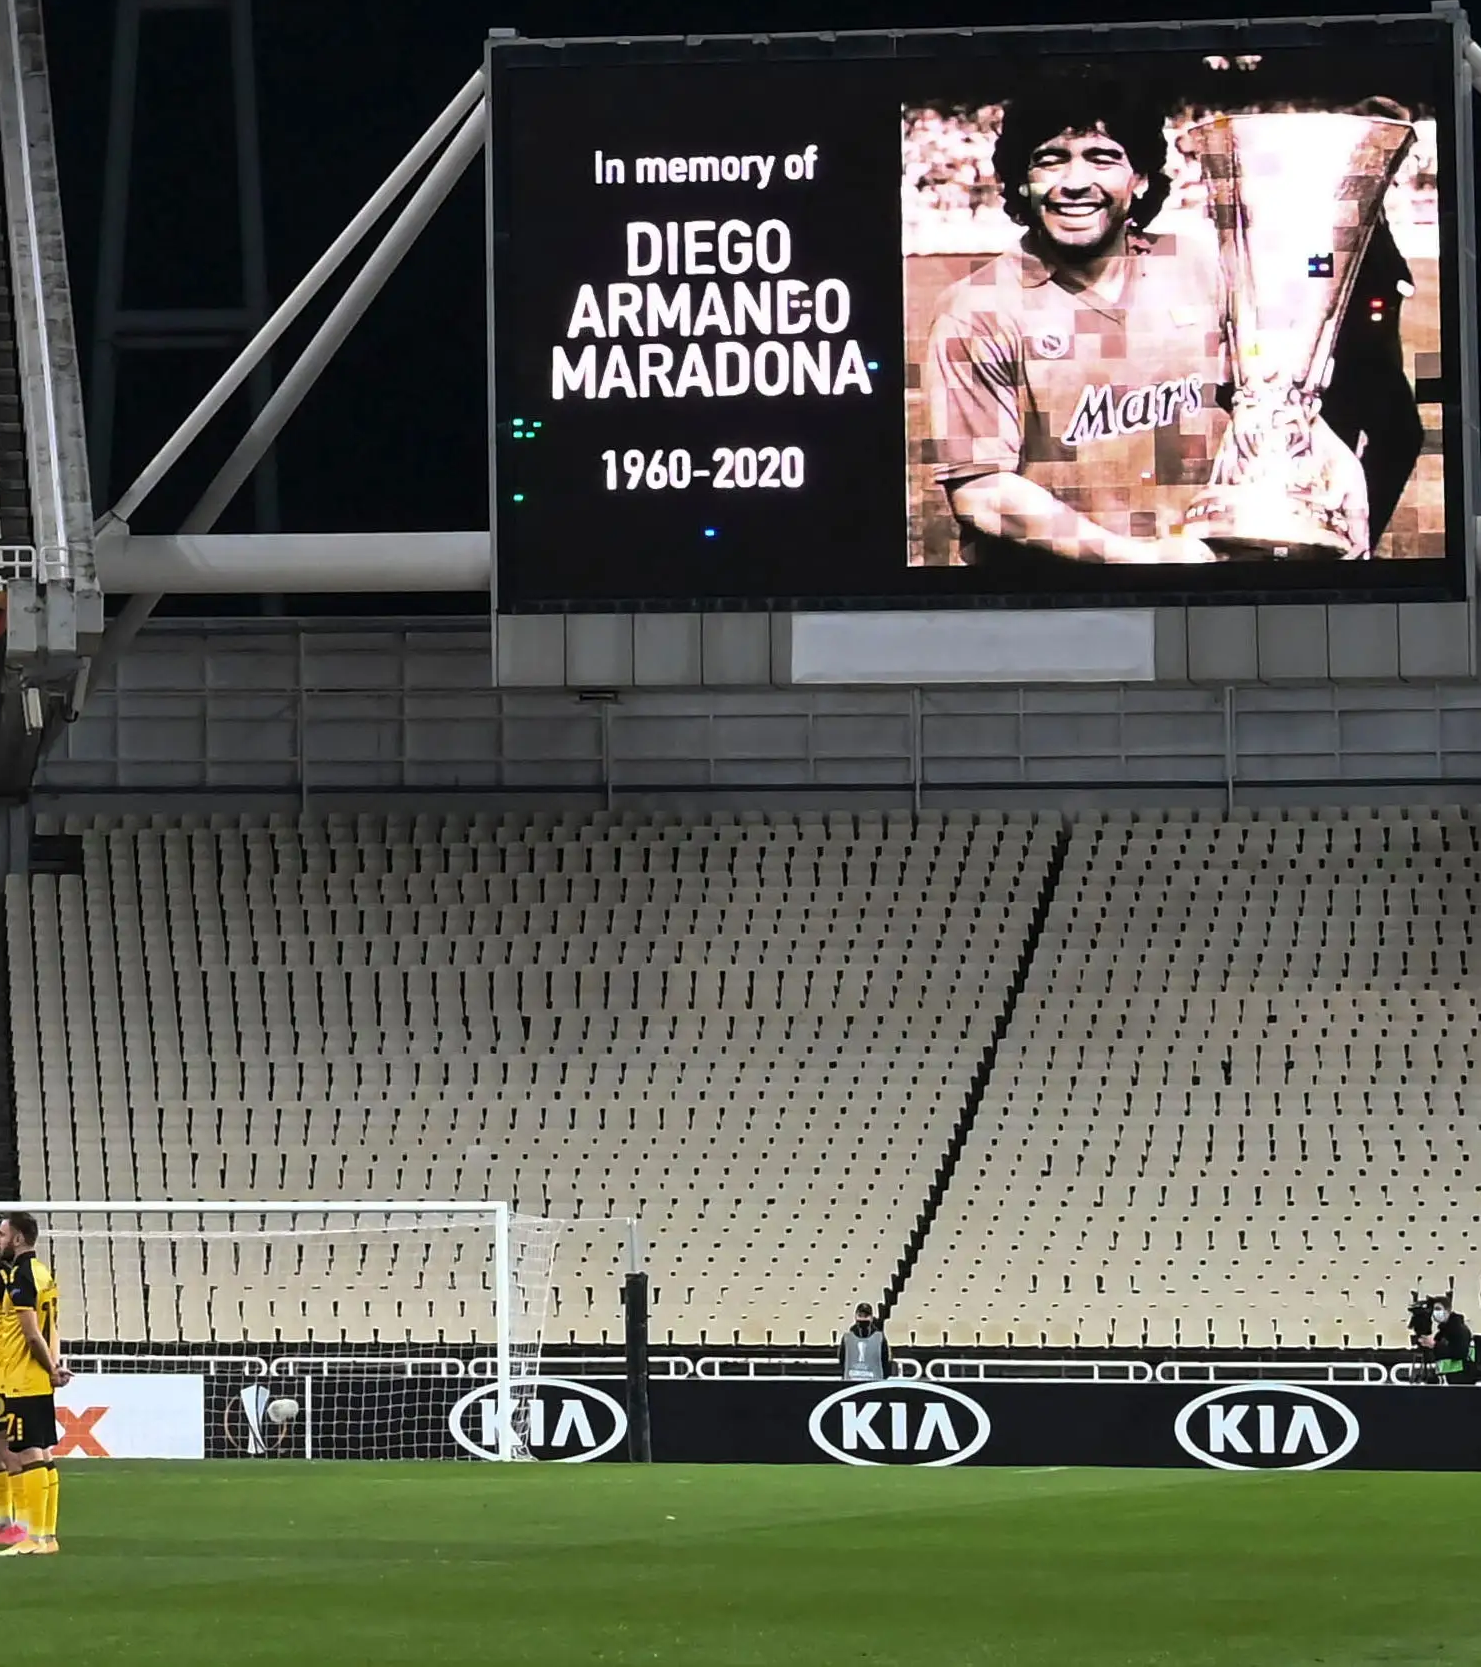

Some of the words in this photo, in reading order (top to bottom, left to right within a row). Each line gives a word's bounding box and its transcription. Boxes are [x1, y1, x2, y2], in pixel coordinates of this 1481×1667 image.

[594, 150, 625, 185] In
[635, 154, 776, 190] memory
[784, 144, 818, 180] of
[626, 218, 792, 277] DIEGO
[566, 277, 851, 339] ARMANDO
[551, 339, 874, 400] MARADONA
[1061, 373, 1204, 446] Mars
[600, 446, 805, 491] 1960-2020
[840, 1400, 960, 1451] KIA
[1206, 1404, 1329, 1455] KIA
